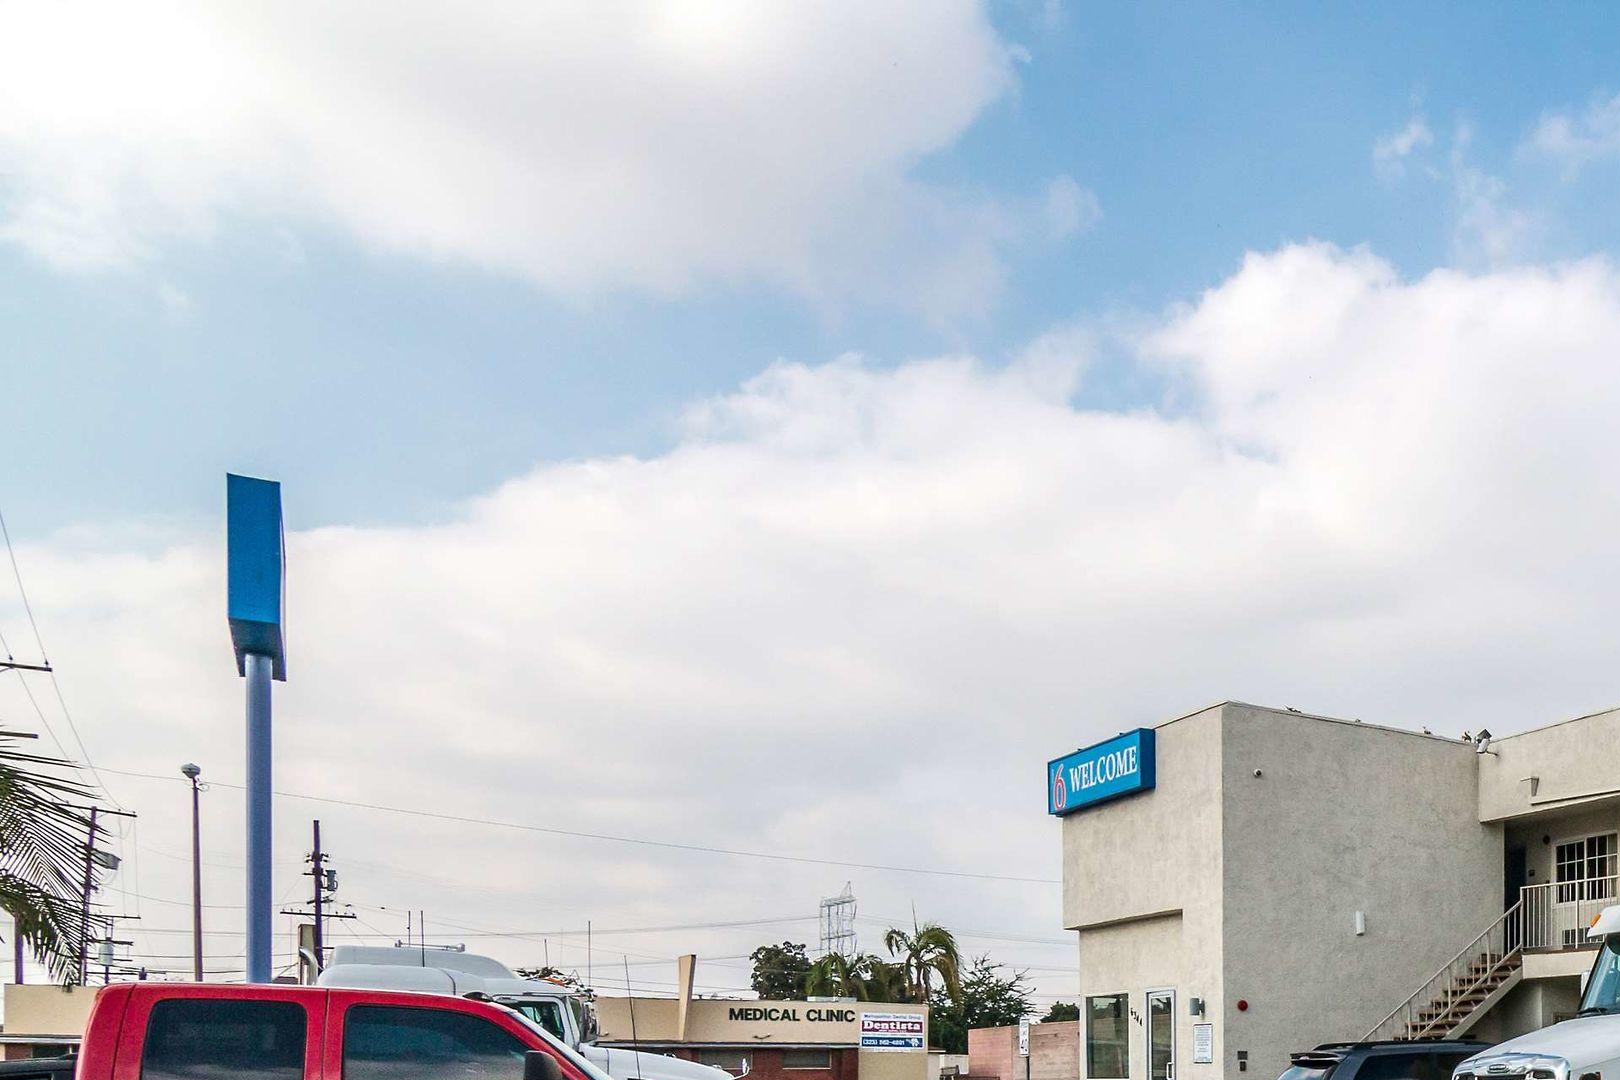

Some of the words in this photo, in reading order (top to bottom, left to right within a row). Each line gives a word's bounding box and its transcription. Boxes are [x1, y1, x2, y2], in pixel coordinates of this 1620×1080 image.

[1069, 746, 1138, 793] WELCOME
[1053, 763, 1067, 811] 6
[729, 1007, 800, 1022] MEDICAL
[806, 1008, 856, 1023] CLINIC
[863, 1020, 921, 1030] Dentista
